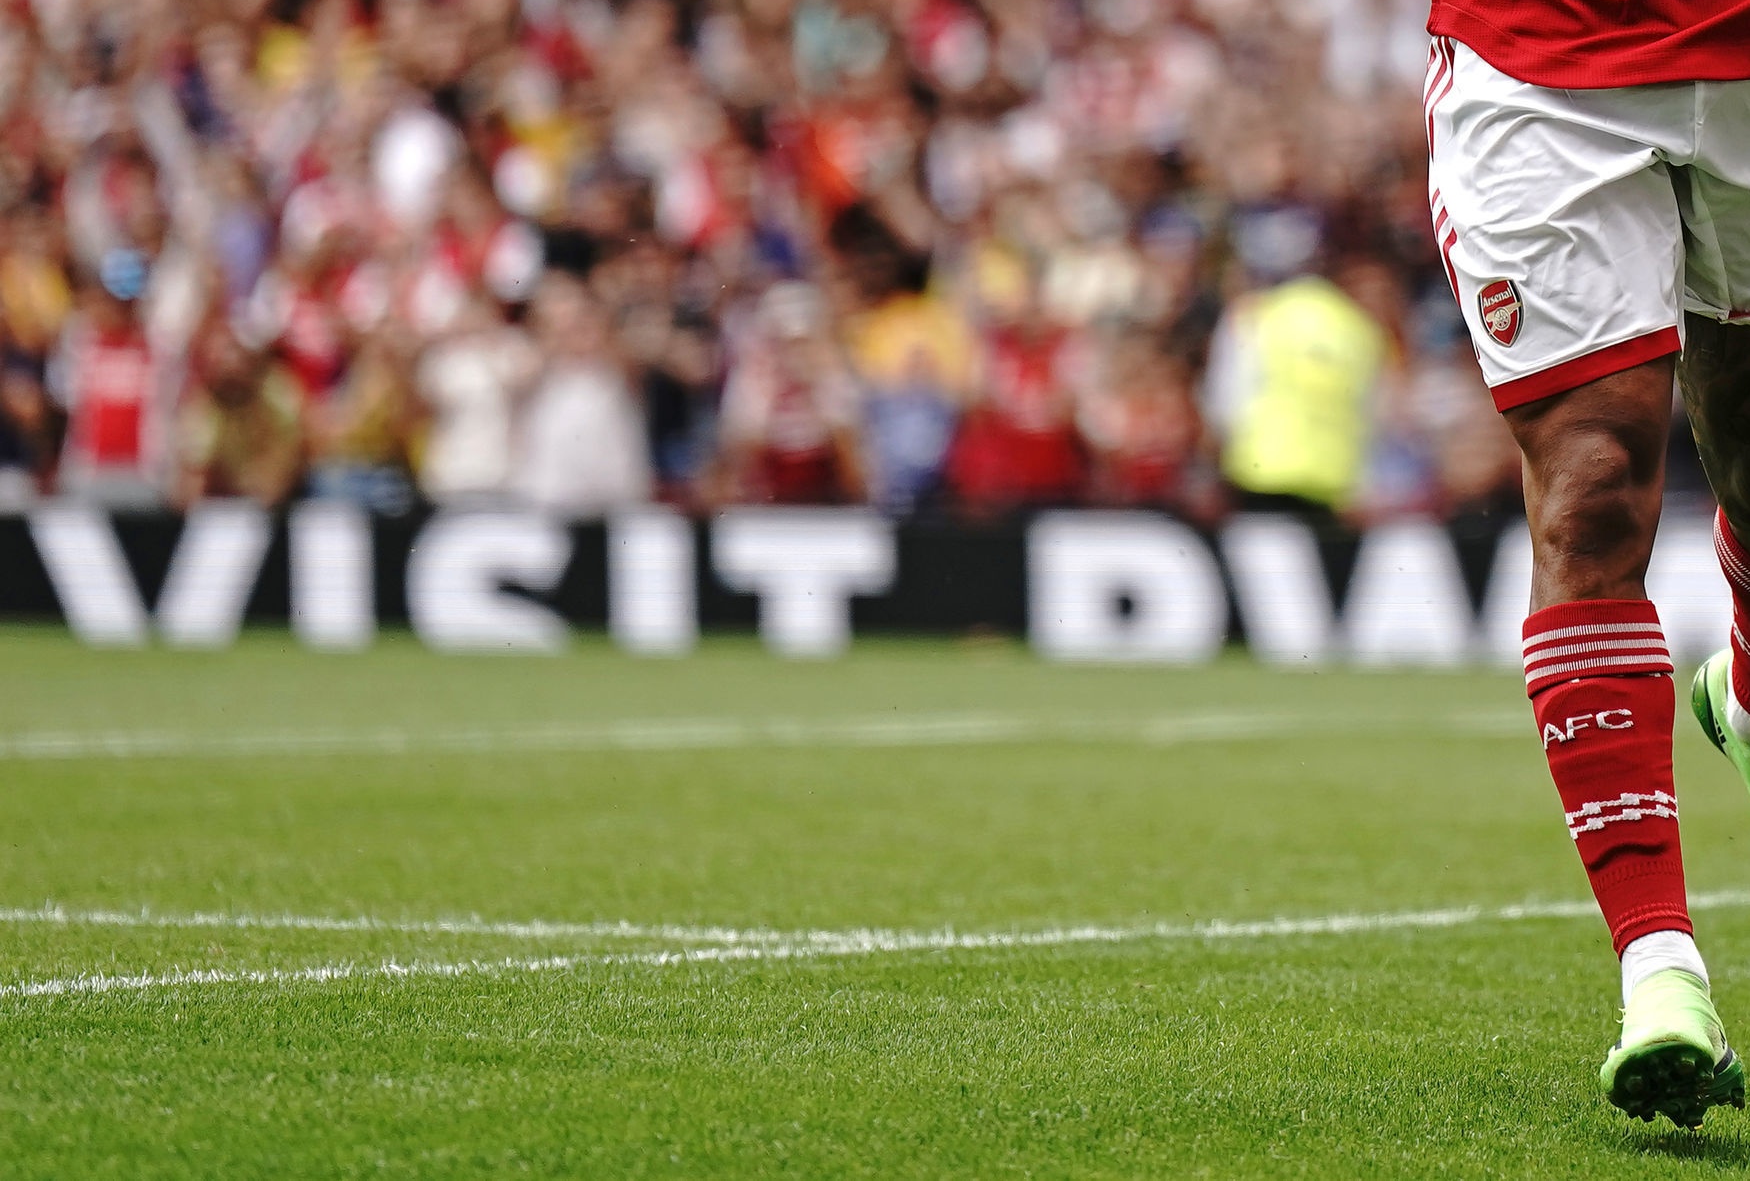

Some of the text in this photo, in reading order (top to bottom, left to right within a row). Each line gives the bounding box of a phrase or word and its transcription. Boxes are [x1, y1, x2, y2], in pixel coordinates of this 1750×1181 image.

[1482, 287, 1513, 308] Arsenal
[27, 504, 899, 654] VISIT
[1543, 708, 1635, 751] AFC
